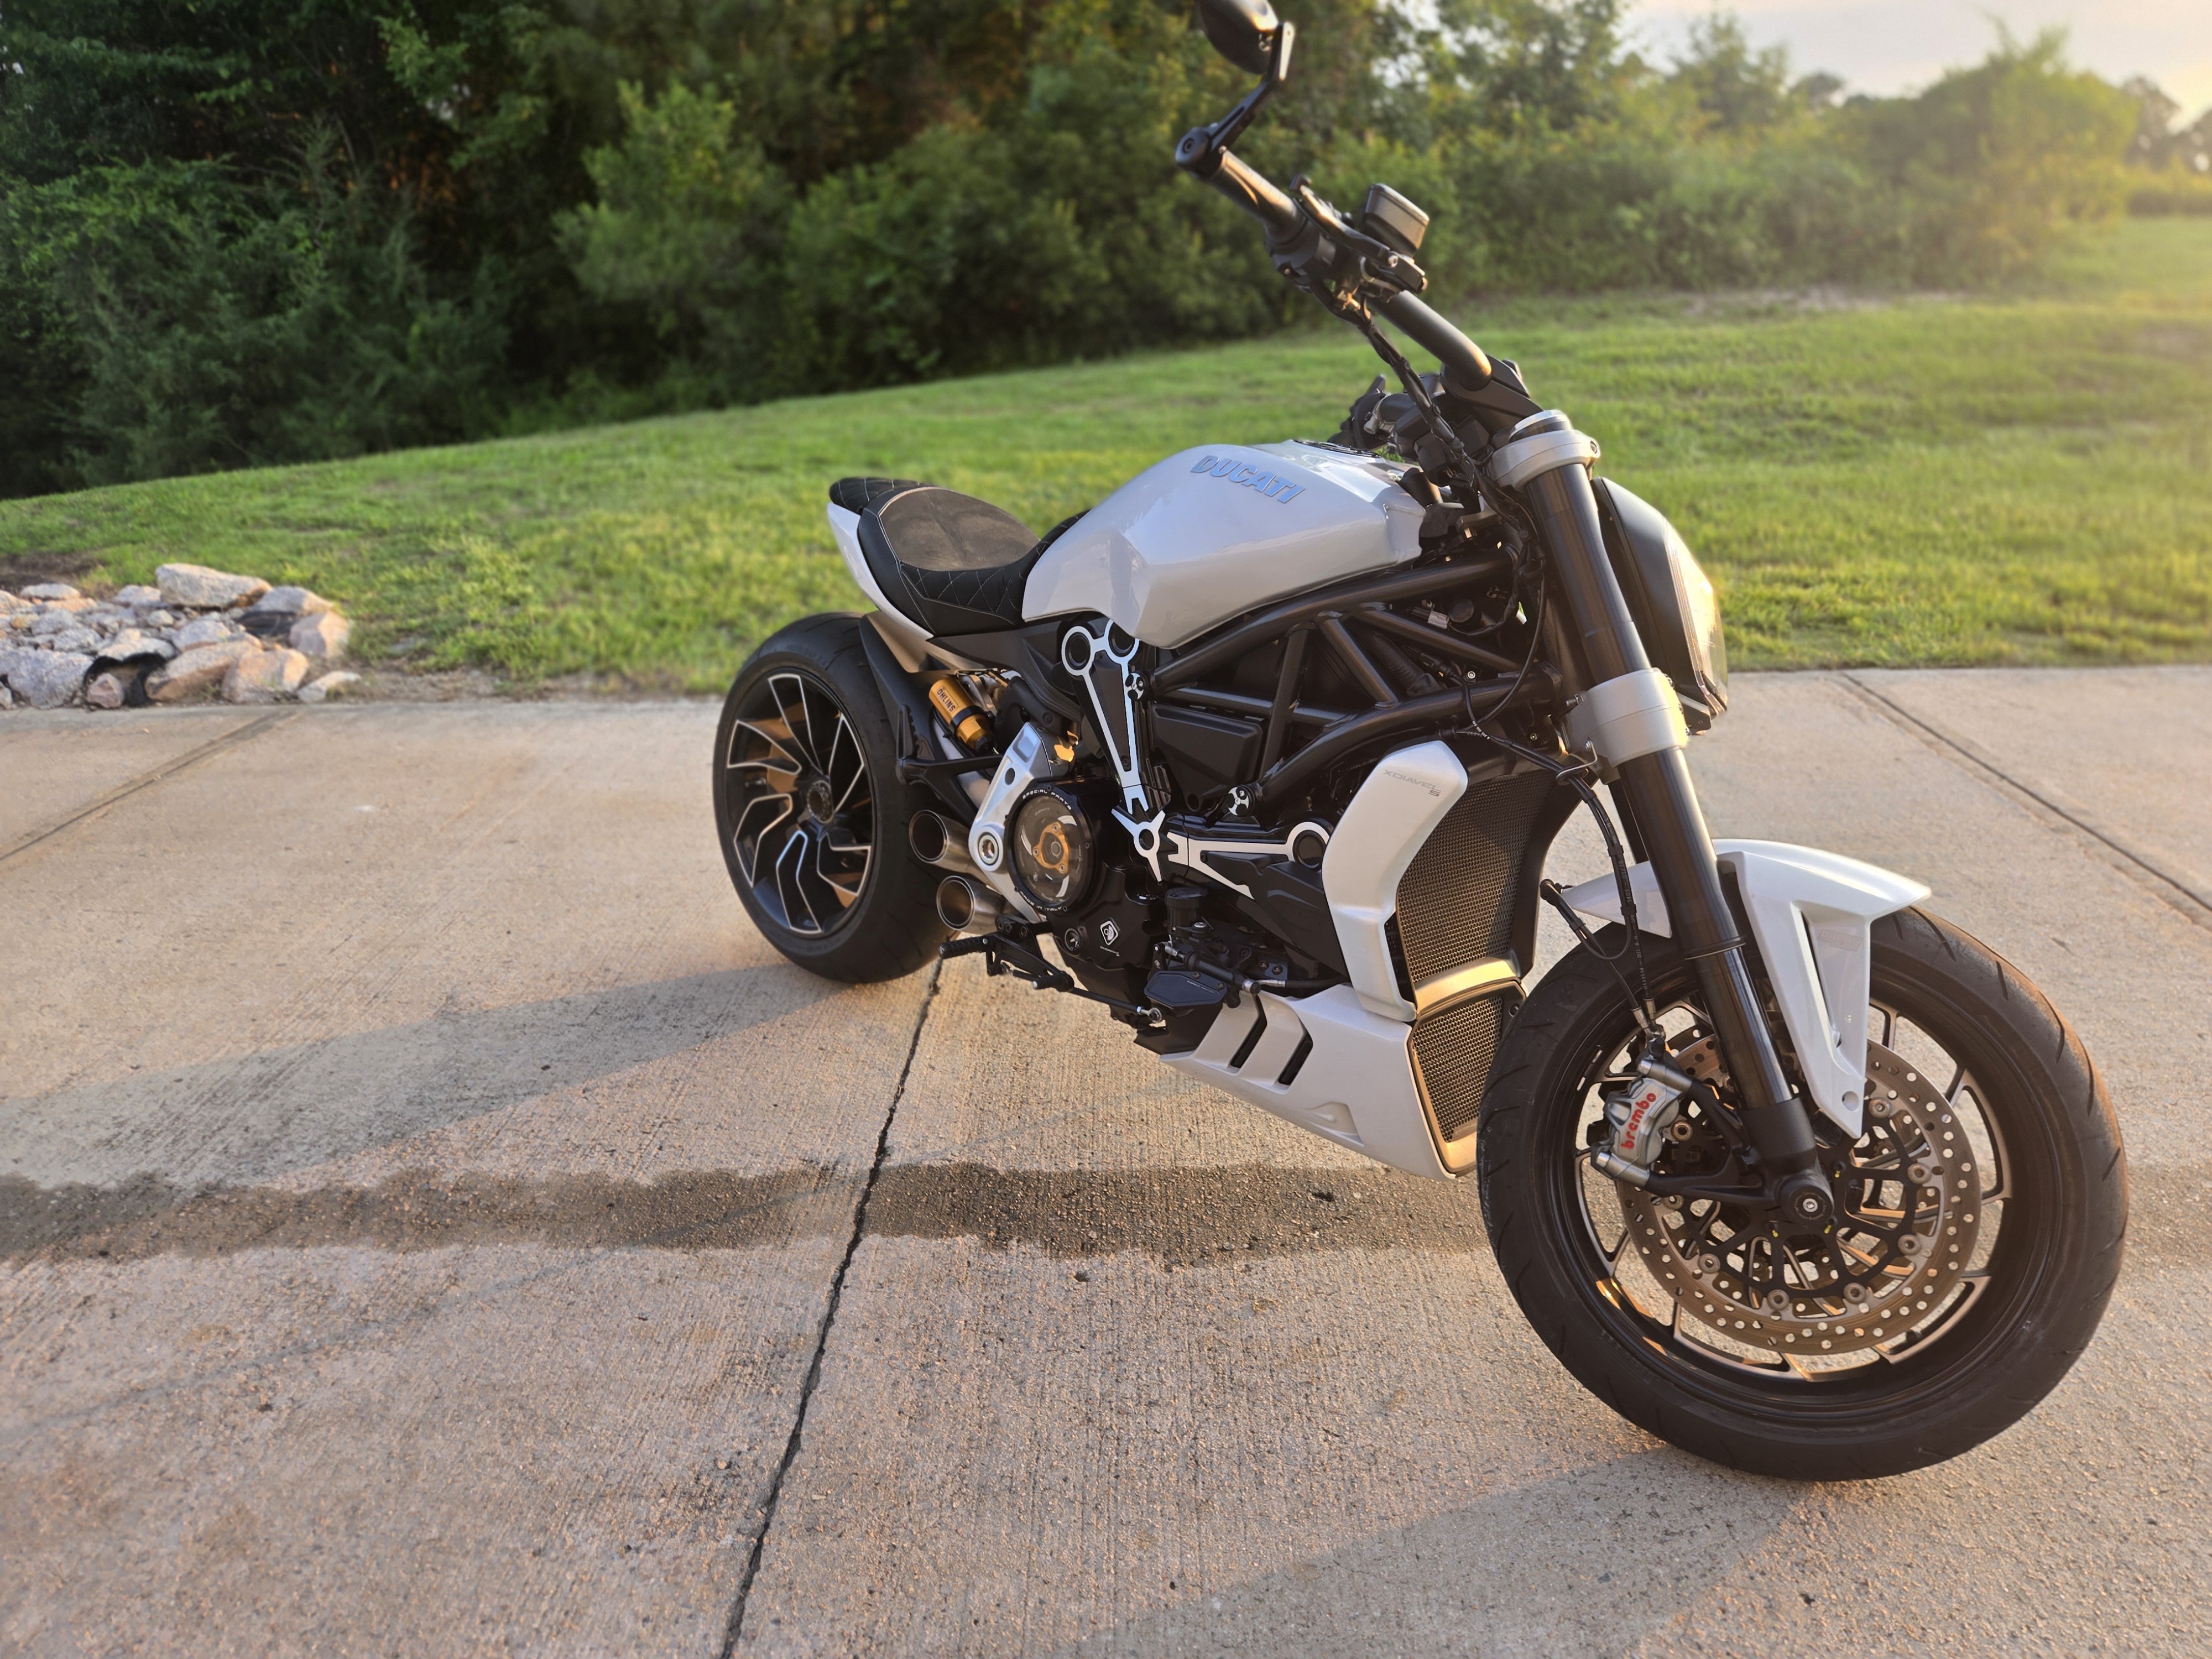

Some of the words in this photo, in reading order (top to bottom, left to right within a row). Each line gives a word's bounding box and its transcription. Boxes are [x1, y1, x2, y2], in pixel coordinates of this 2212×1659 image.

[1190, 455, 1306, 504] DUCATI
[1384, 769, 1442, 792] XDIAVEL
[1022, 789, 1047, 800] SPECIAL
[1051, 792, 1072, 810] PARTS
[1621, 1093, 1656, 1150] brembo
